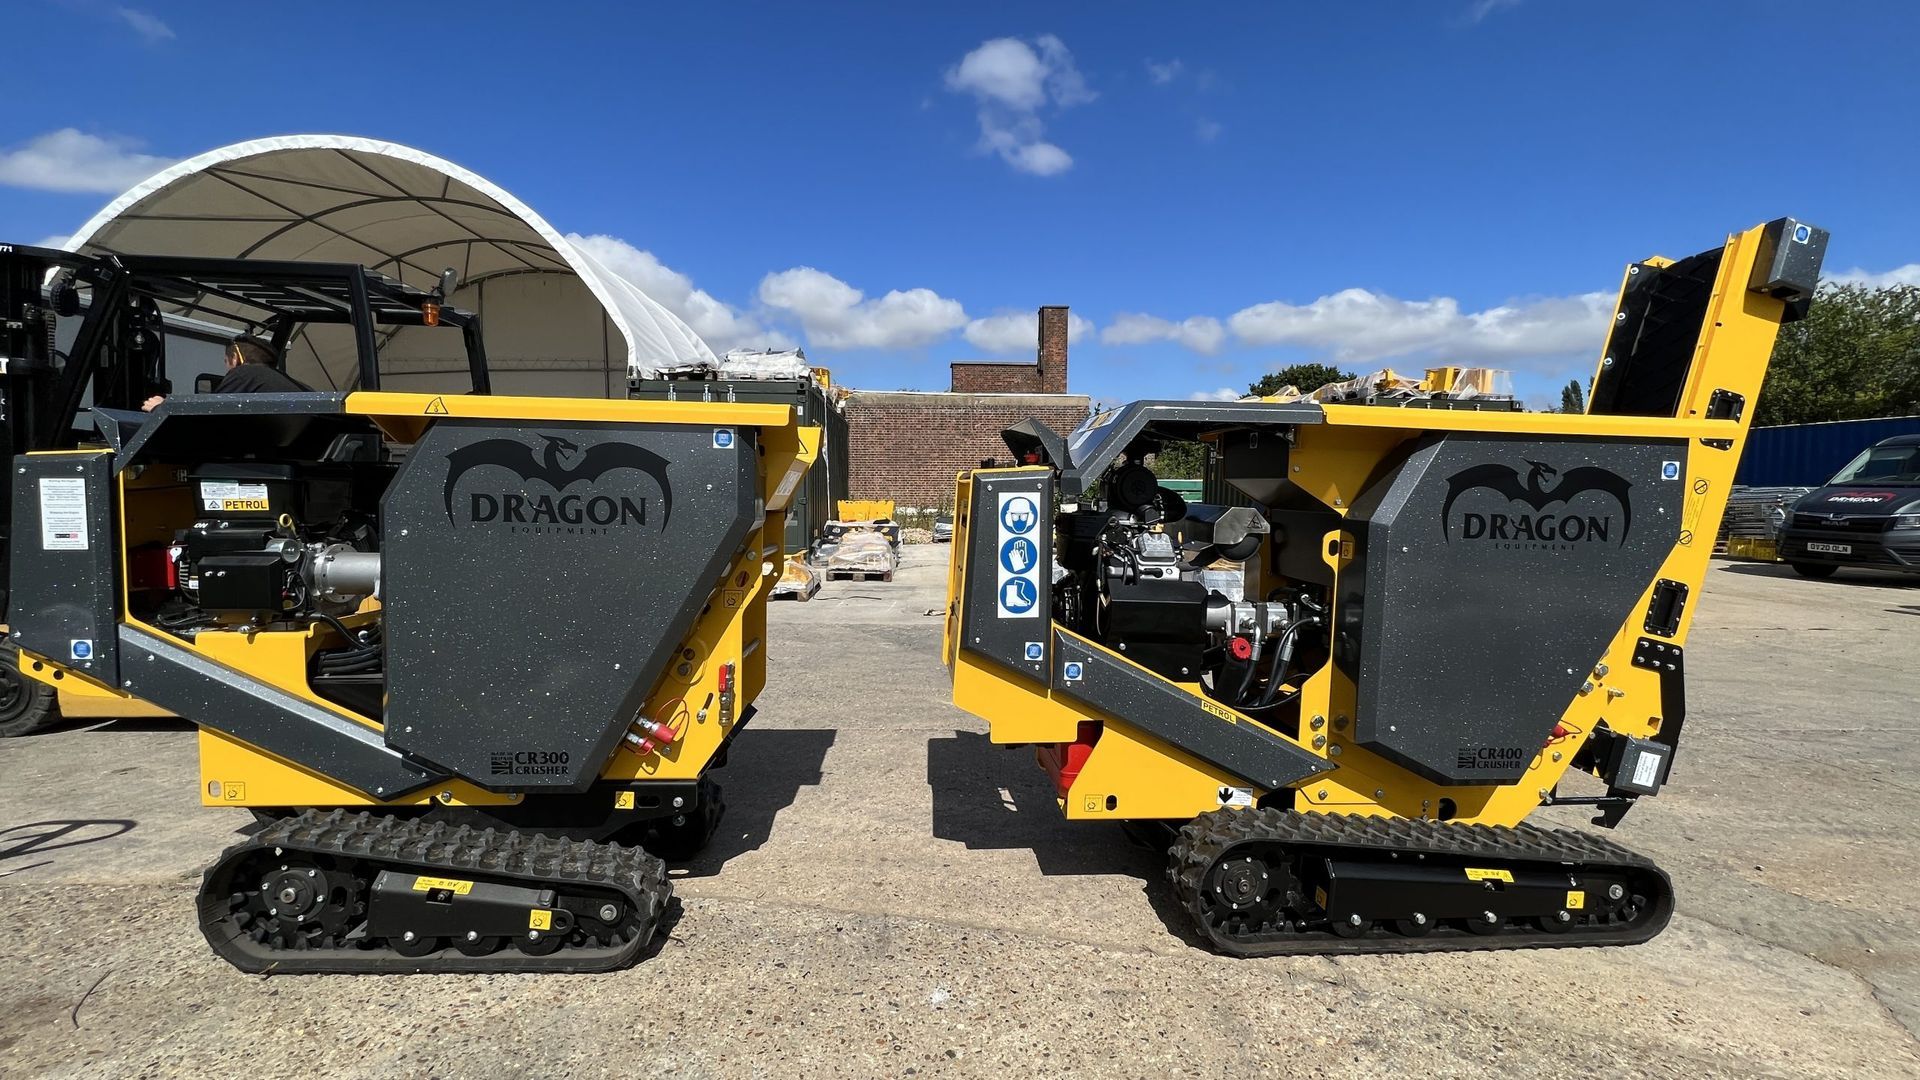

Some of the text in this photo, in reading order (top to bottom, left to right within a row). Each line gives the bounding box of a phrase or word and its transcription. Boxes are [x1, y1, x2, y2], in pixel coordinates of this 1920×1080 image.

[225, 501, 268, 509] PETROL
[471, 493, 646, 526] DRAGON
[511, 526, 608, 535] EQUIPMENT
[1463, 513, 1610, 543] DRAGON
[1203, 702, 1236, 722] PETROL
[515, 751, 569, 765] CR300
[1478, 747, 1523, 760] CR400
[514, 765, 569, 775] CRUSHER
[1477, 760, 1521, 769] CRUSHER
